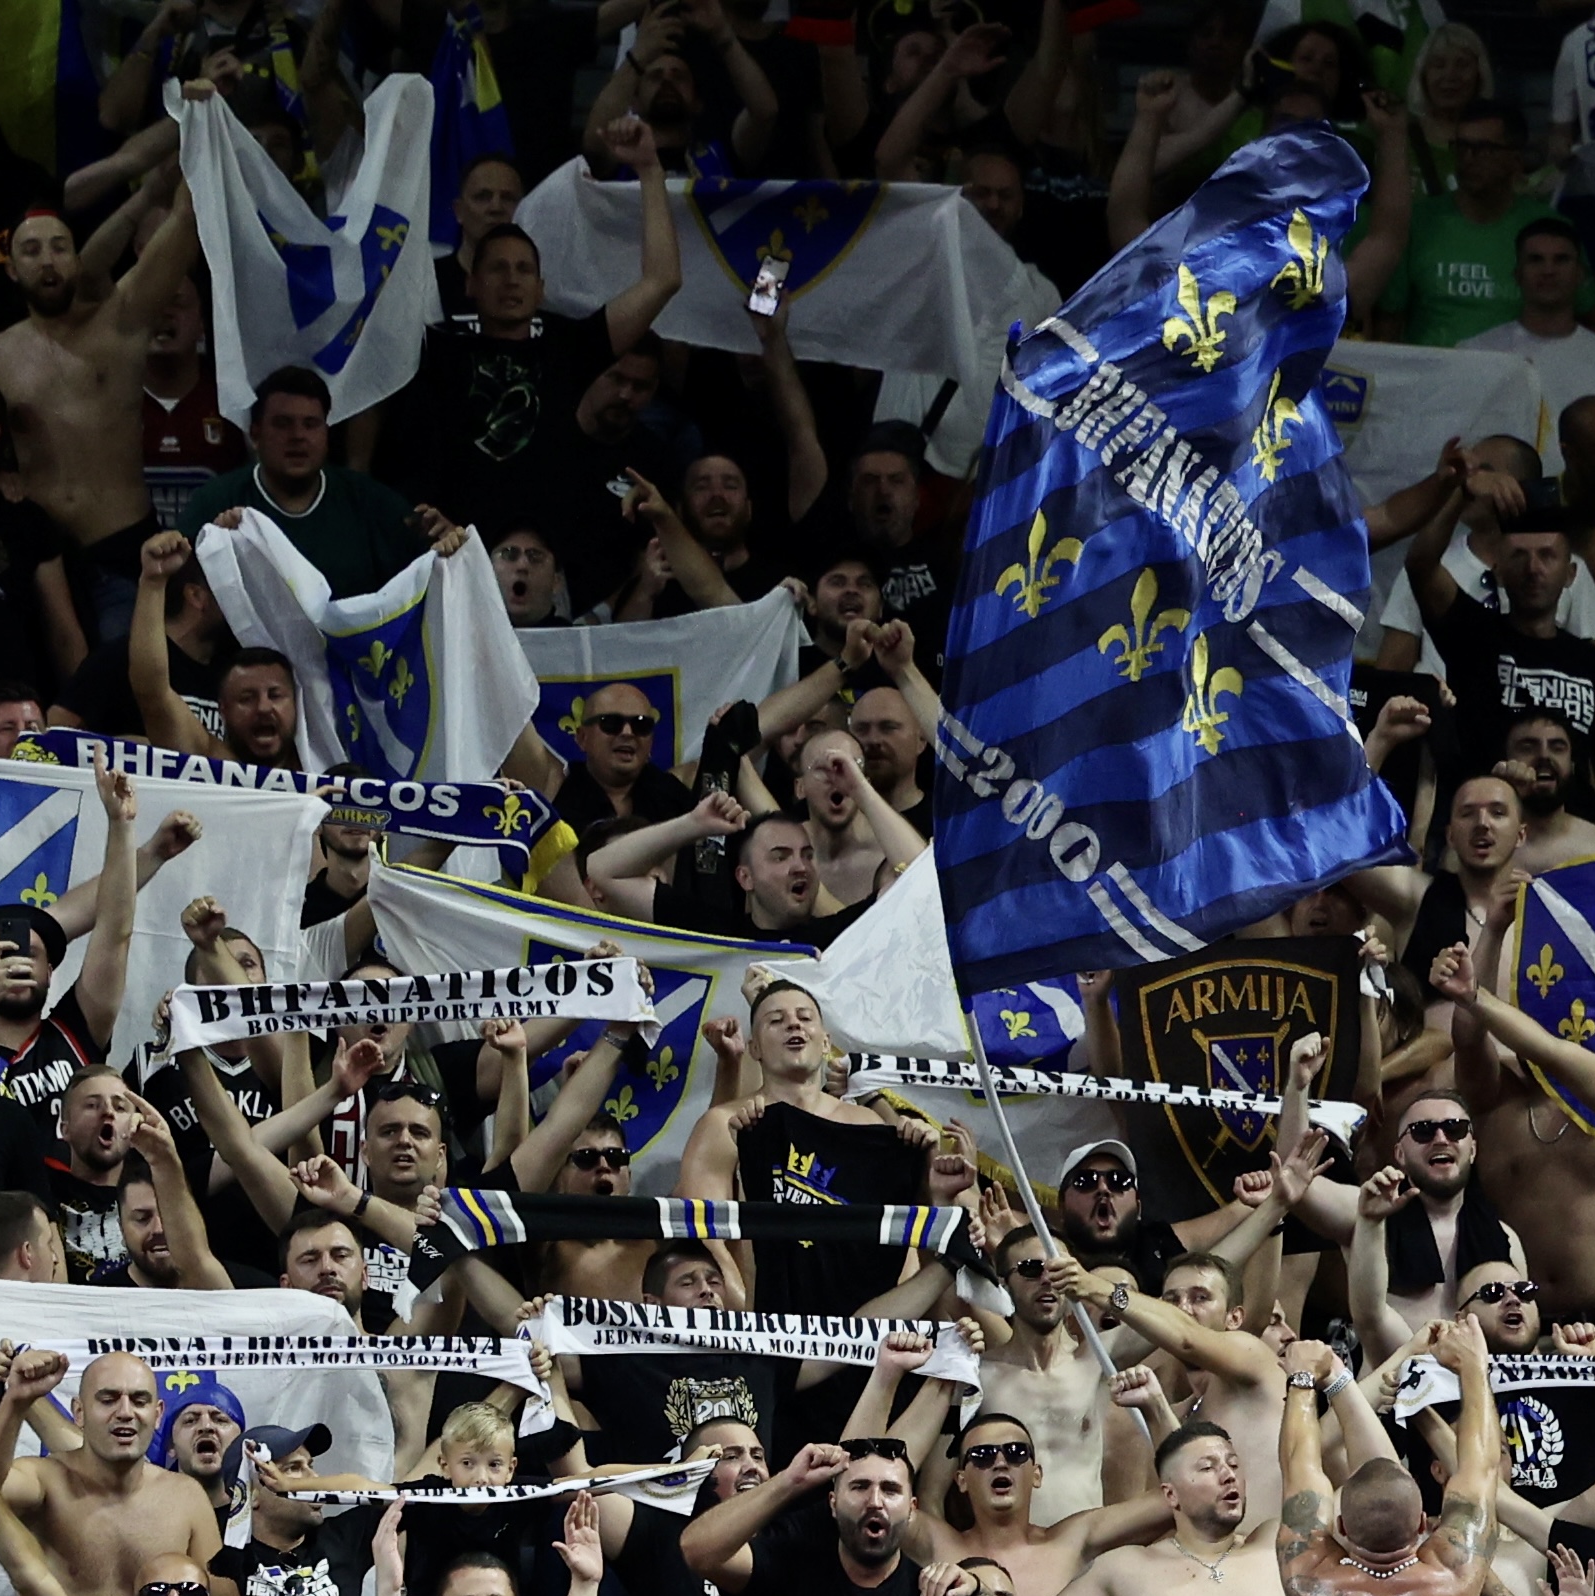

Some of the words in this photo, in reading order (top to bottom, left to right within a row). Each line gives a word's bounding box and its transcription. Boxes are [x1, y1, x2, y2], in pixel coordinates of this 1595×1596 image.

[1449, 262, 1491, 280] FEEL
[1054, 361, 1282, 625] BHFANATICOS
[965, 746, 1102, 883] 2000
[198, 960, 616, 1024] BHFANATICOS
[1164, 974, 1318, 1035] ARMIJA
[248, 1010, 359, 1037] BOSNIAN
[366, 1002, 482, 1024] SUPPORT
[490, 999, 561, 1018] ARMY
[562, 1294, 674, 1328] BOSNA
[684, 1306, 698, 1330] I
[141, 1352, 190, 1368] EDNA
[196, 1352, 215, 1367] SI
[312, 1353, 366, 1368] MOJA
[373, 1353, 479, 1369] DOMOVINA
[594, 1329, 654, 1347] JEDNA
[662, 1332, 680, 1345] SI
[769, 1338, 820, 1357] MOJA
[824, 1339, 876, 1362] DOMO
